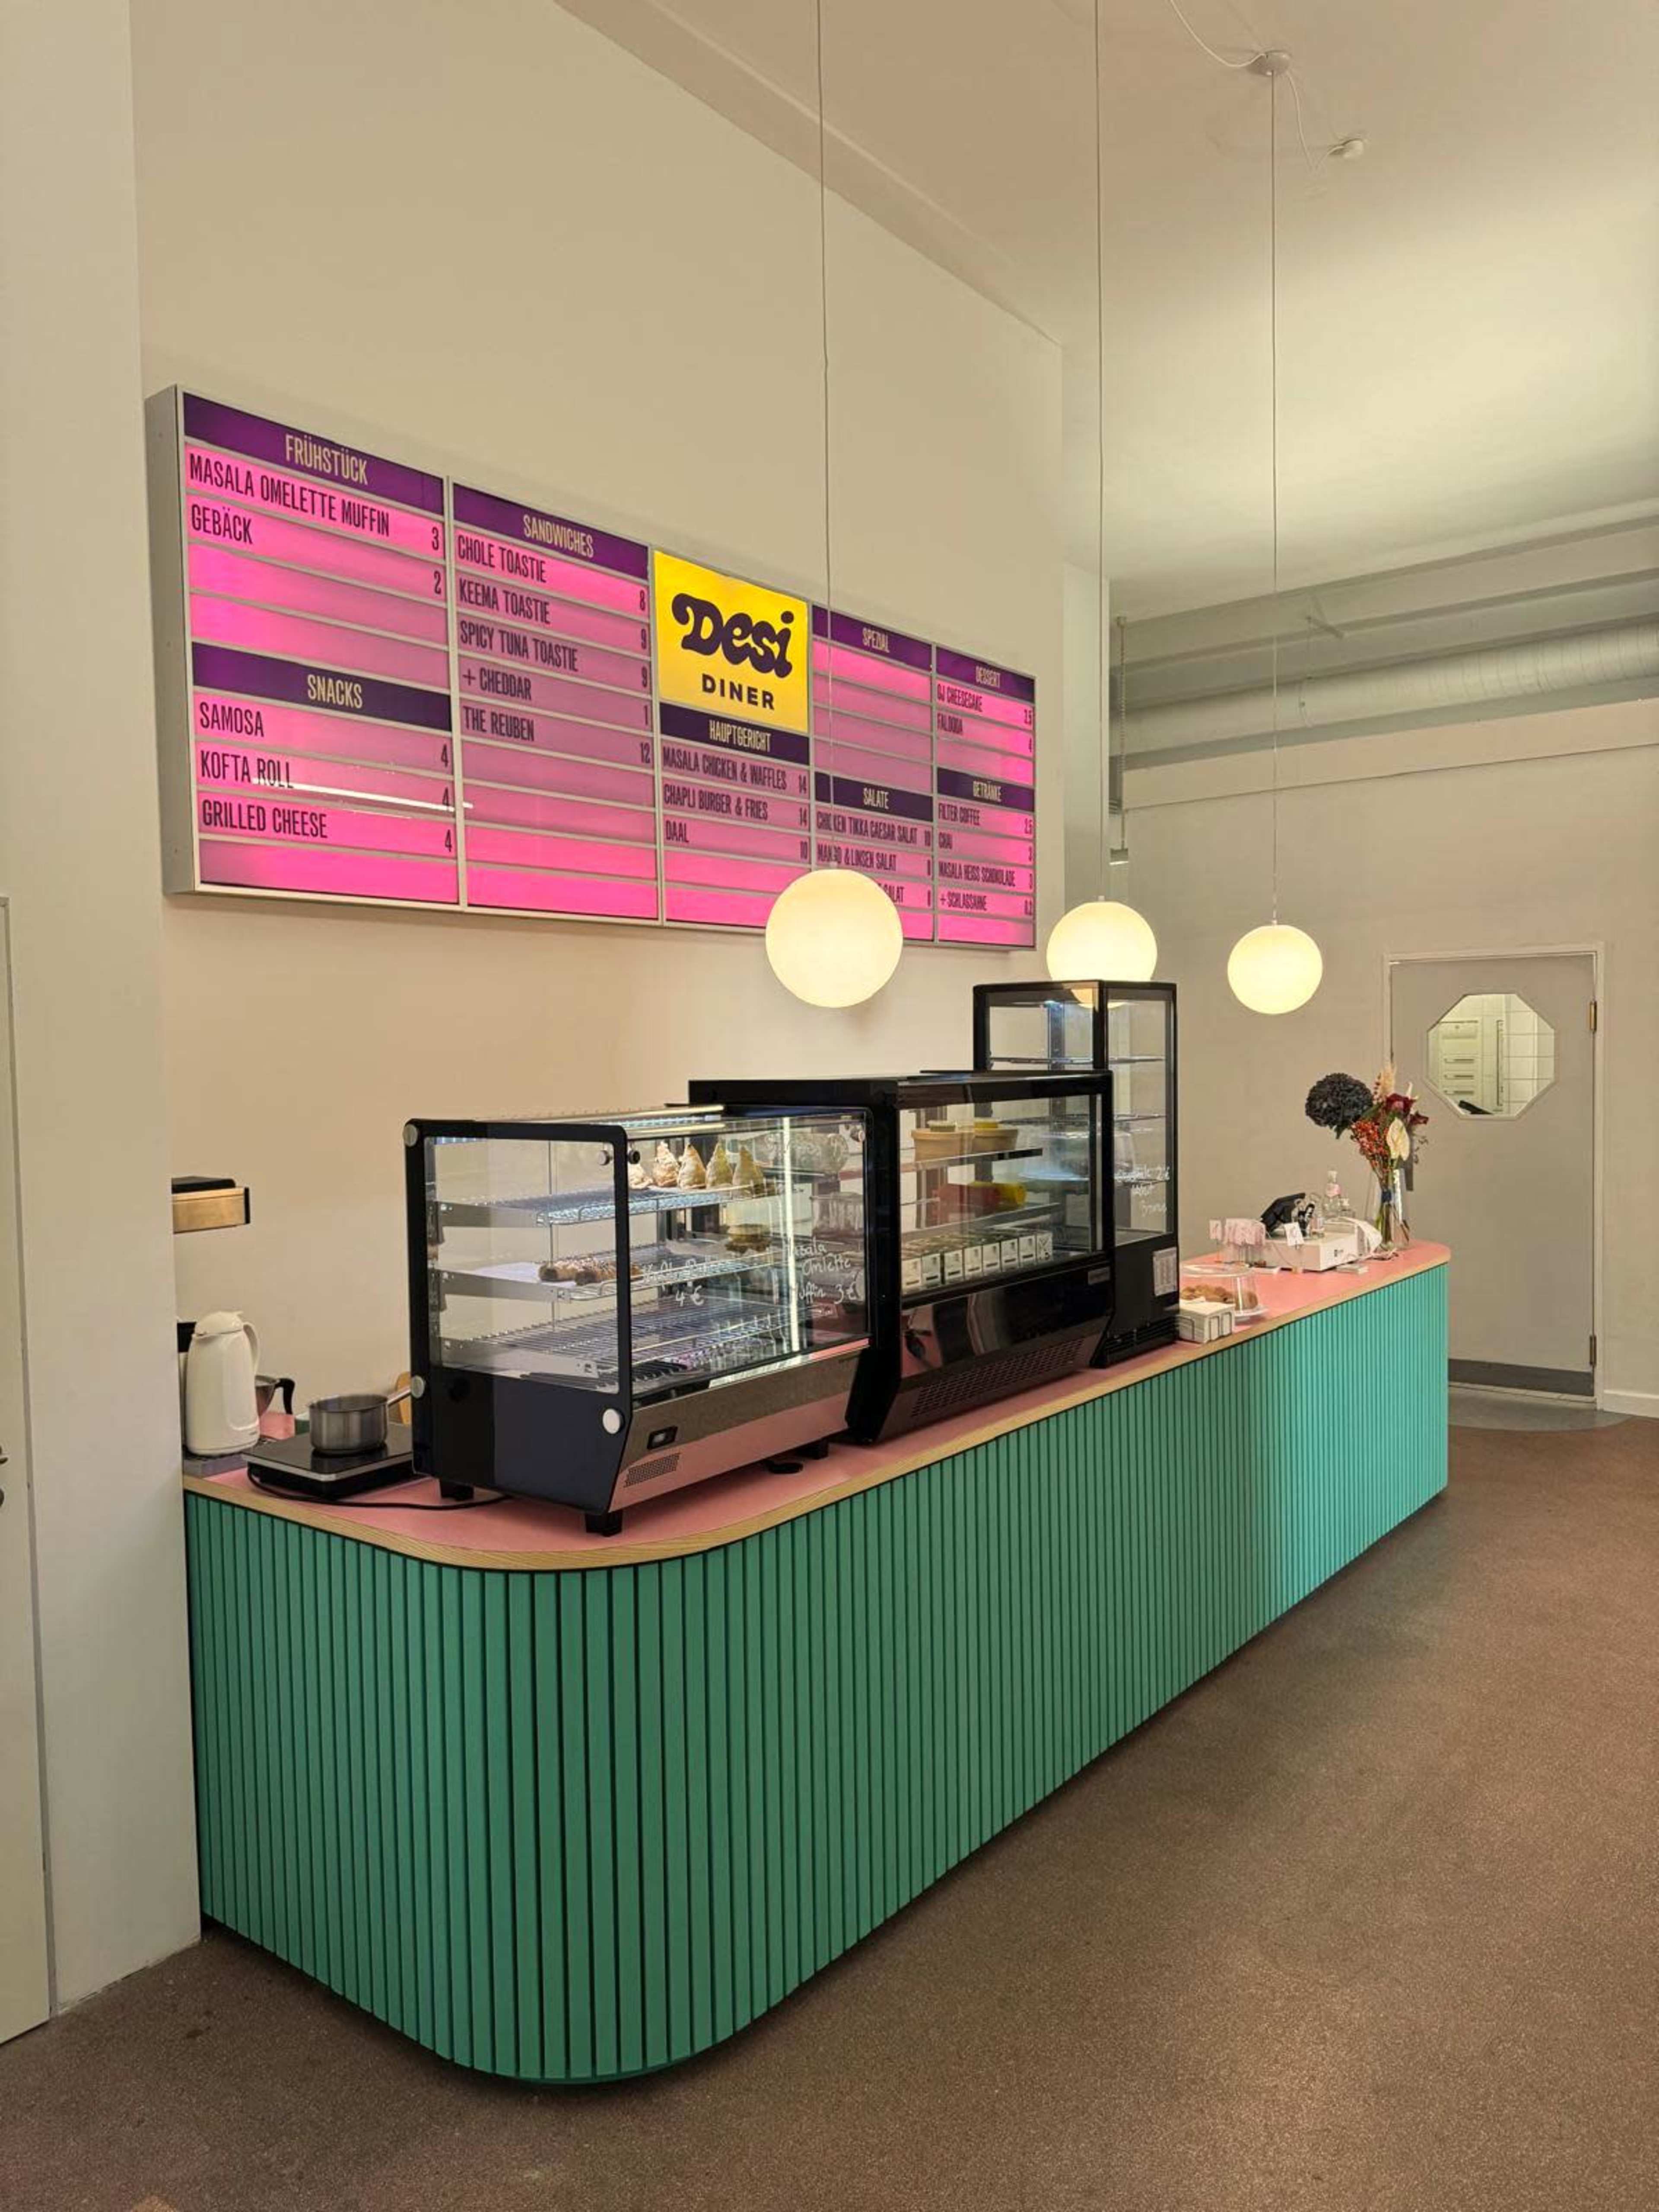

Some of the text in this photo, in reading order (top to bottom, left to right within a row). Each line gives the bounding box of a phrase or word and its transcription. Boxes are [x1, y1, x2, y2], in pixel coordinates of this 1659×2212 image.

[285, 433, 368, 485] FRÜHSTÜCK
[190, 454, 439, 550] MASALA OMELETTE MUFFIN 3
[191, 503, 441, 594] GEBÄCK 2
[523, 515, 594, 558] SANDWICHES
[458, 535, 645, 611] CHOLE TOASTIE 8
[459, 578, 647, 649] KEEMA TOASTIE 9
[672, 593, 794, 678] Desi
[460, 621, 647, 688] SPICY TUNA TOASTIE 9
[307, 674, 363, 709] SNACKS
[463, 667, 648, 726] + CHEDDAR 1
[702, 673, 775, 710] DINER
[200, 702, 448, 767] SAMOSA 4
[463, 706, 650, 764] THE REUBEN 12
[709, 719, 771, 752] HAUPTGERICHT
[200, 750, 450, 810] KOFTA ROLL 4
[663, 747, 700, 772] MASALA
[702, 754, 737, 782] CHICKEN
[740, 763, 747, 783] &
[750, 765, 787, 790] WAFFLES
[664, 784, 696, 808] CHAPLI
[699, 790, 731, 815] BURGER
[735, 797, 742, 816] &
[745, 798, 768, 820] FRIES
[863, 788, 889, 810] SALATE
[959, 807, 980, 826] COFFEE
[202, 799, 452, 852] GRILLED CHEESE 4
[666, 820, 689, 843] DAAL
[848, 816, 868, 837] TIKKA
[870, 820, 896, 841] CAESAR
[897, 825, 917, 845] SALAT
[876, 852, 896, 871] SALAT
[675, 1289, 685, 1307] 4
